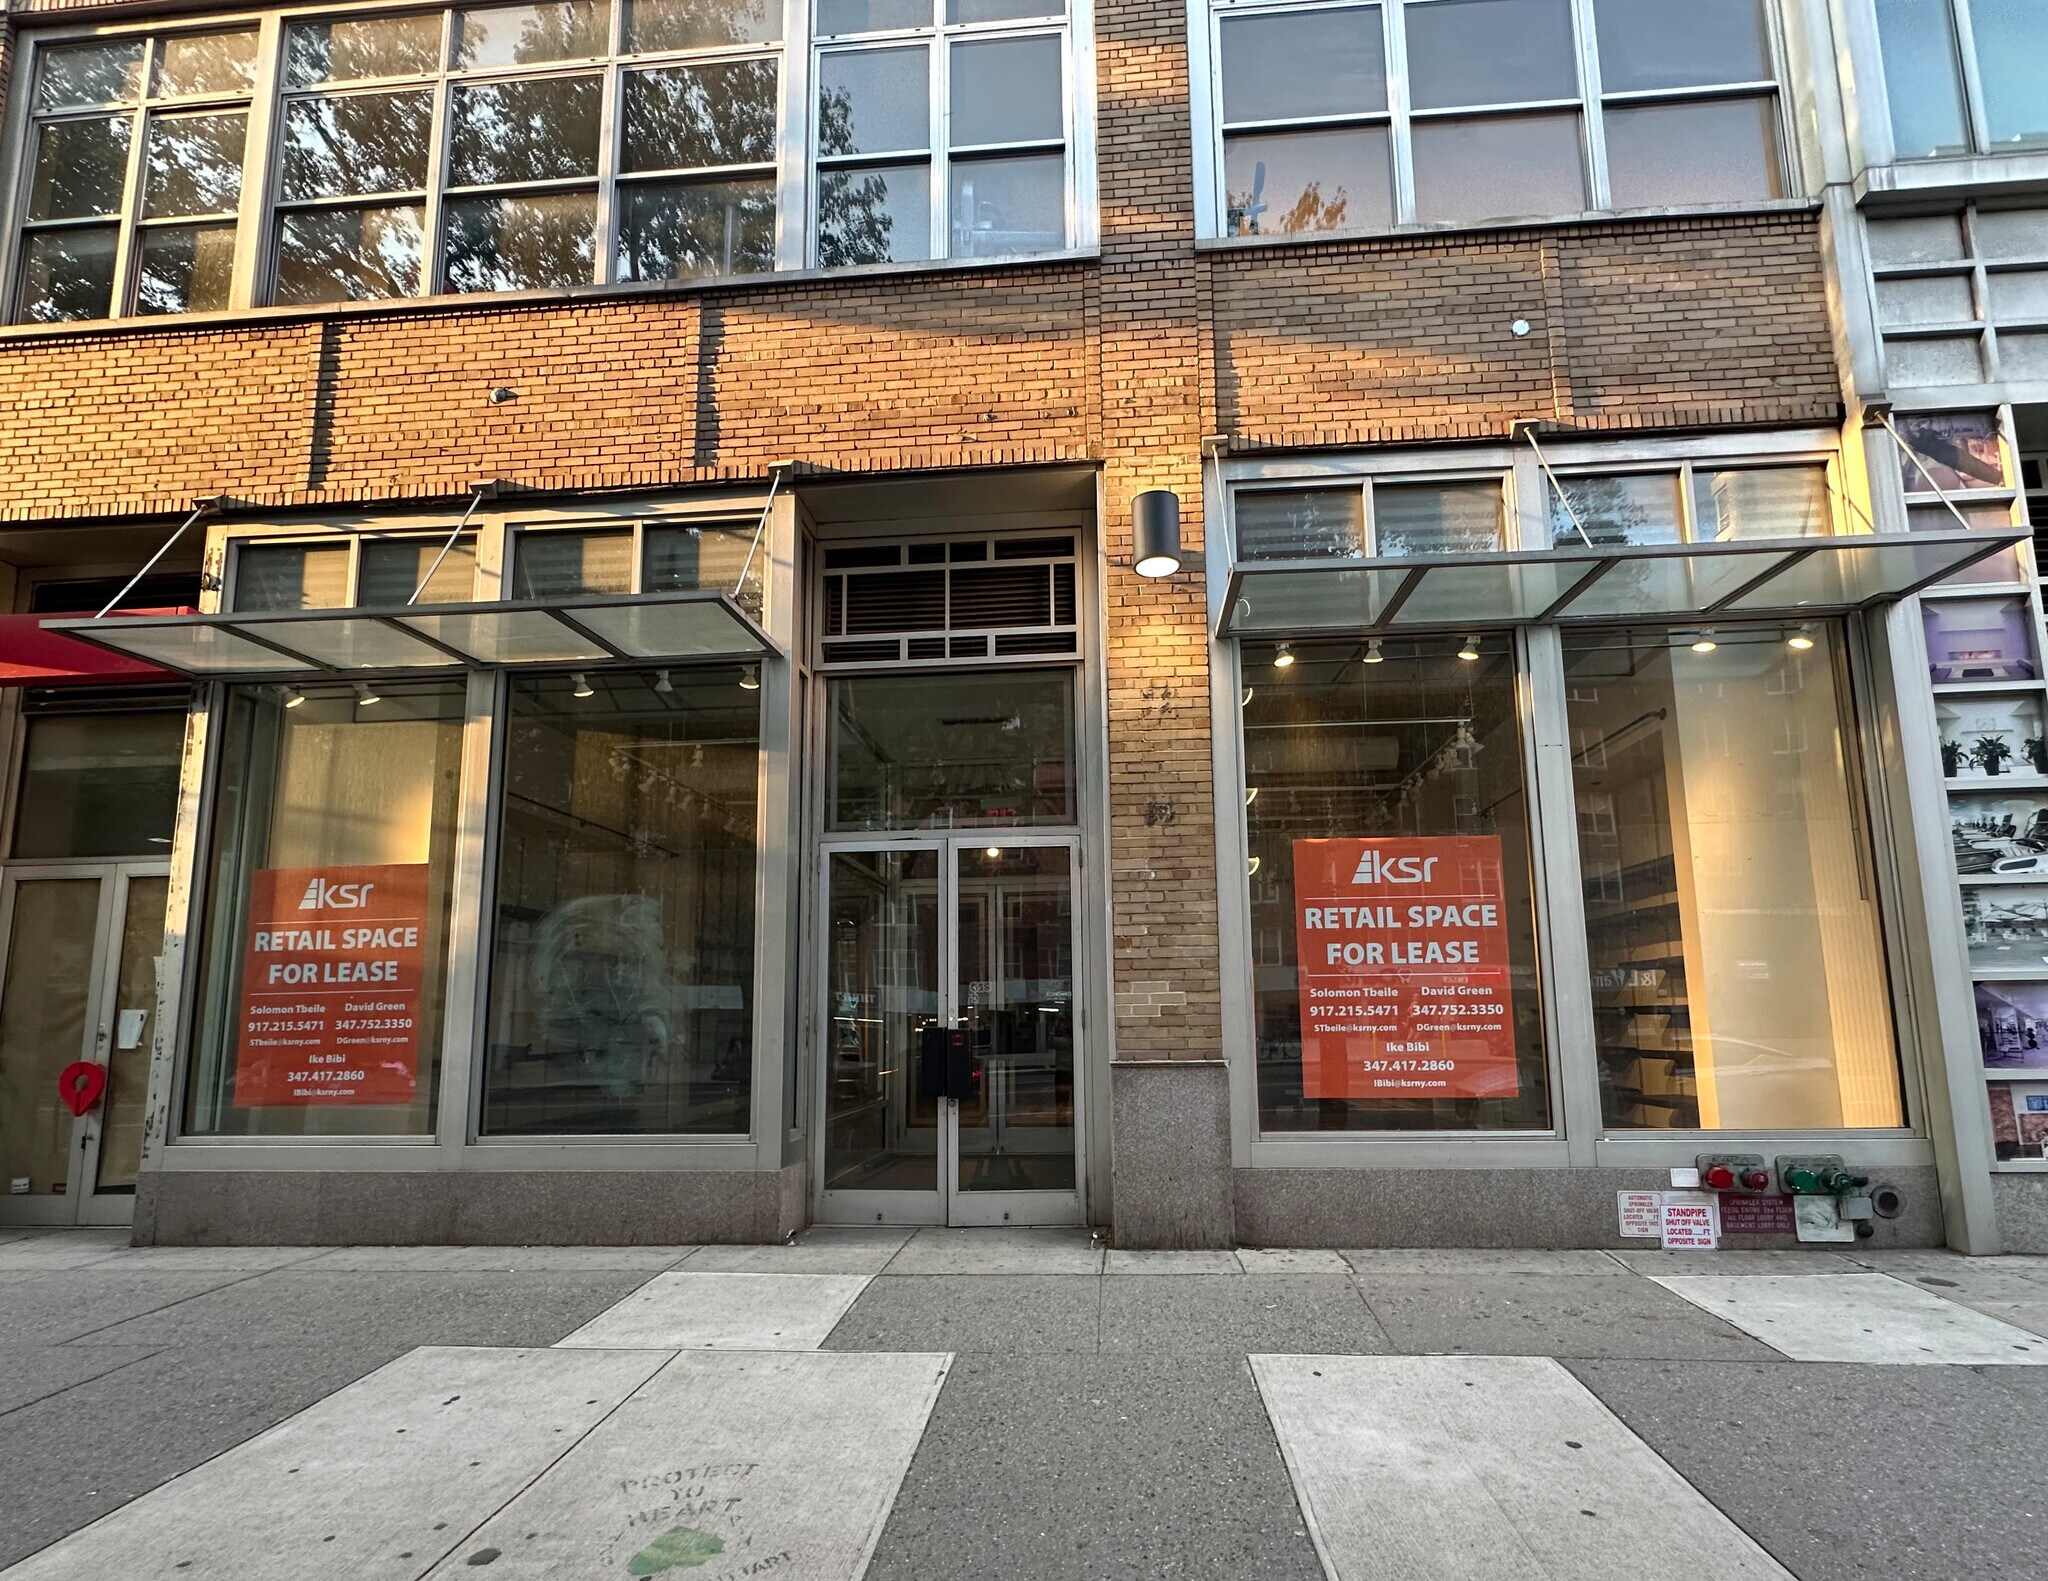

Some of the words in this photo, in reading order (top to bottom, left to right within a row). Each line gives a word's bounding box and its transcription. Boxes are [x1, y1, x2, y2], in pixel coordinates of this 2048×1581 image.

[1305, 907, 1401, 929] RETAIL
[1409, 905, 1497, 927] SPACE
[255, 930, 335, 952] RETAIL
[342, 927, 418, 949] SPACE
[1327, 943, 1383, 965] FOR
[1391, 941, 1479, 964] LEASE
[269, 963, 317, 984] FOR
[324, 961, 398, 982] LEASE
[1310, 988, 1360, 998] Solomon
[1363, 988, 1398, 997] Tbeile
[1421, 986, 1456, 996] David
[1459, 986, 1492, 995] Green
[250, 1005, 294, 1014] Solomon
[296, 1005, 326, 1013] Tbeile
[345, 1003, 374, 1012] David
[376, 1002, 405, 1011] Green
[1310, 1006, 1399, 1016] 917.215.5471
[1412, 1004, 1504, 1016] 347.752.3350
[248, 1022, 324, 1032] 917.215.5471
[335, 1020, 412, 1029] 347.752.3350
[1416, 1023, 1502, 1032] DGreen@ksrny.com
[1386, 1042, 1404, 1052] Ike
[1406, 1042, 1430, 1052] Bibi
[309, 1055, 324, 1063] Ike
[326, 1054, 345, 1063] Bibi
[1363, 1060, 1454, 1071] 347.417.2860
[287, 1071, 365, 1081] 347.417.2860
[1667, 1209, 1706, 1217] STANDPIPE
[619, 1463, 760, 1493] PROTECT
[627, 1497, 742, 1527] HEART
